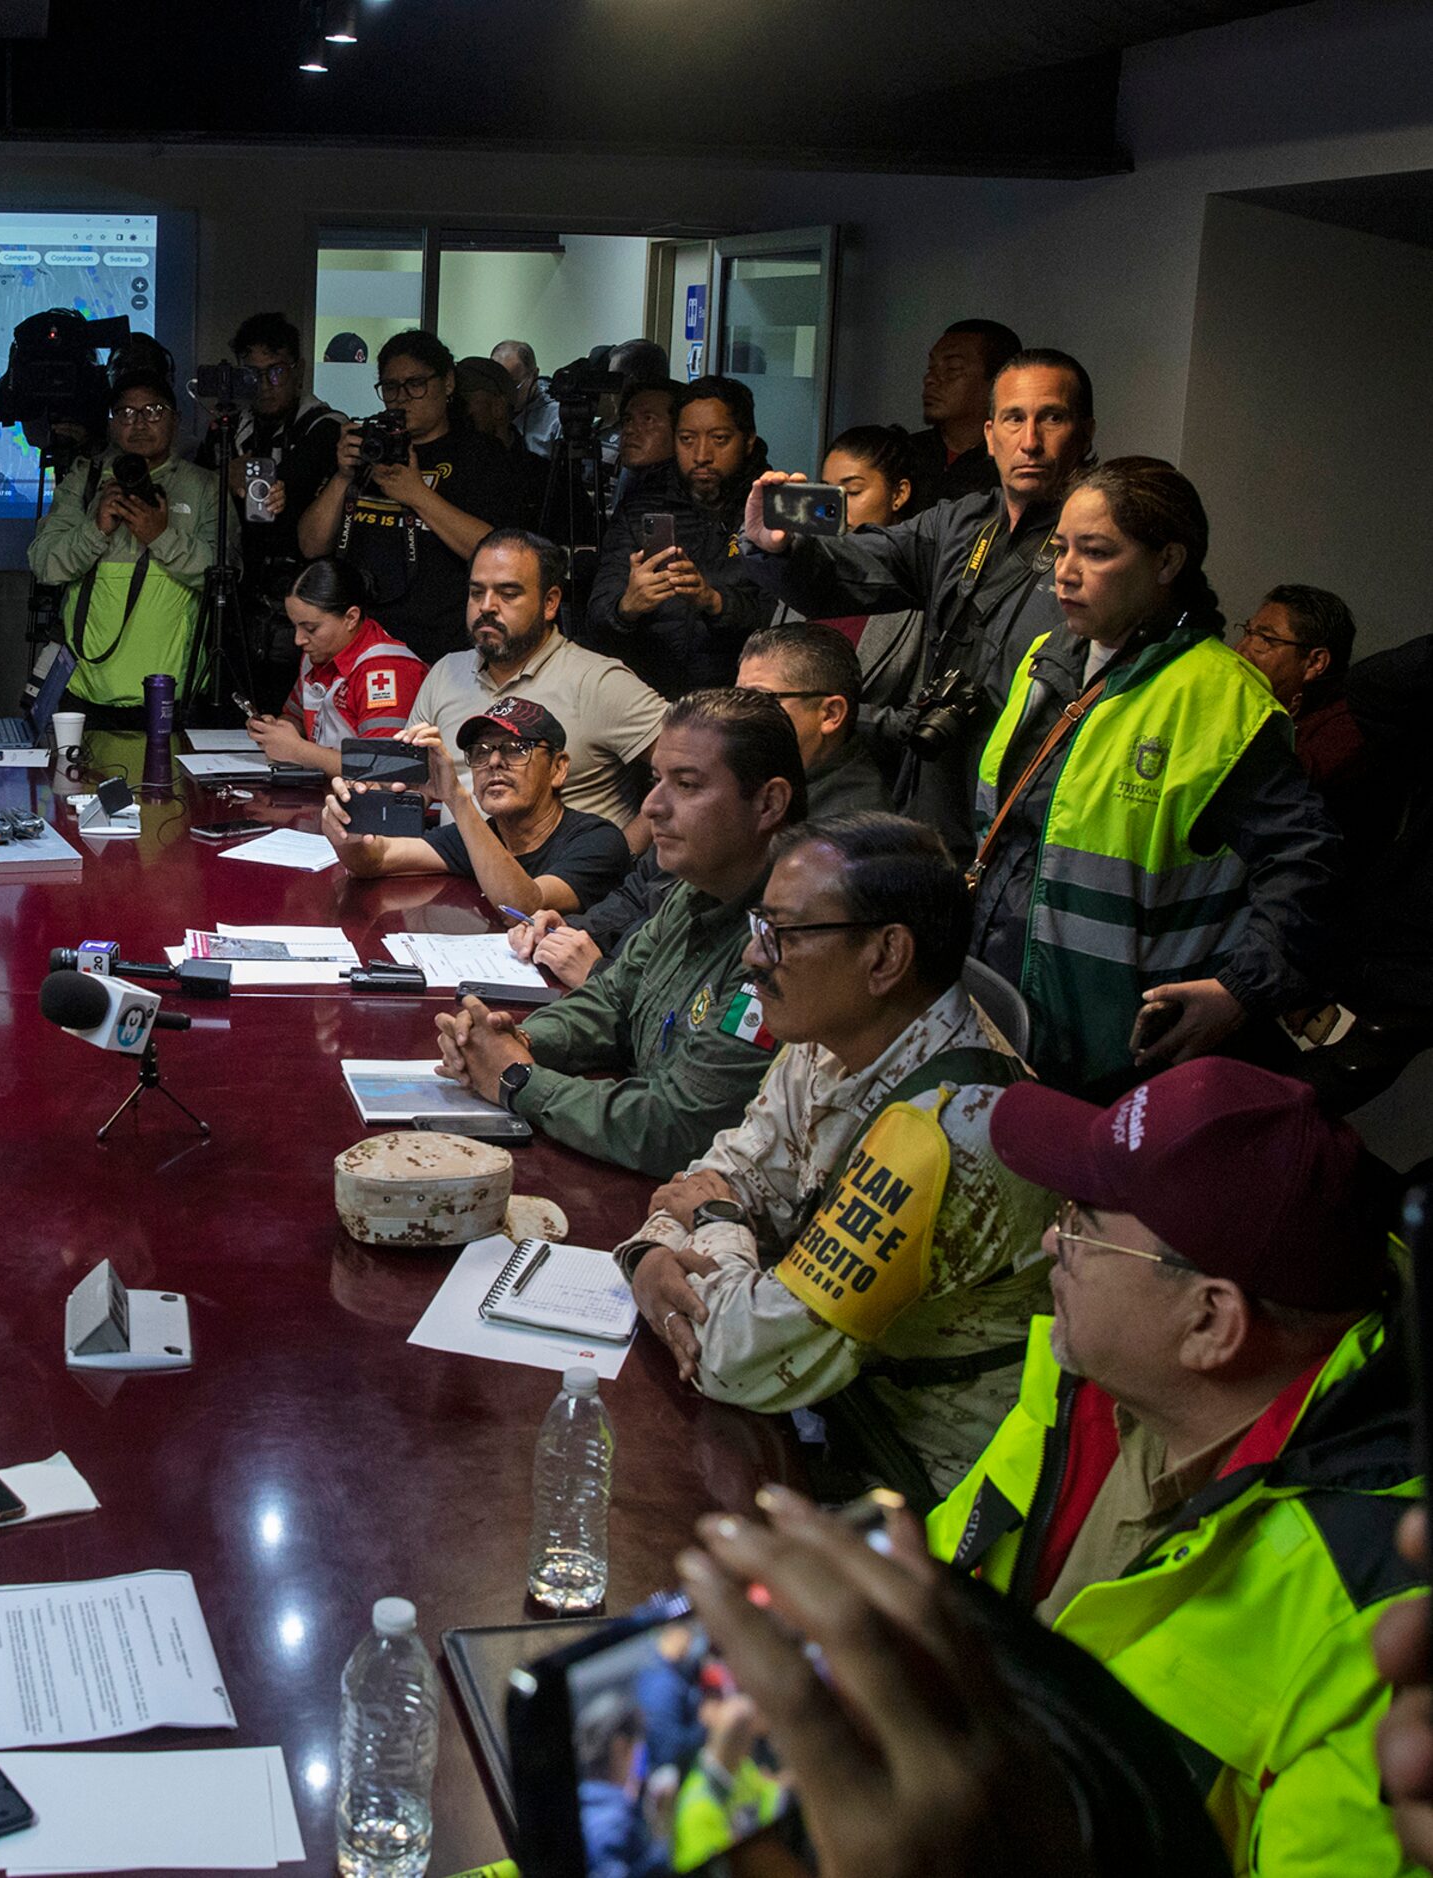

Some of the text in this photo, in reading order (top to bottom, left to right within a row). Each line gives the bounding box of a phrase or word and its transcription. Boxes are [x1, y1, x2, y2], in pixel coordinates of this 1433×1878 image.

[3, 253, 35, 262] Compartir
[51, 254, 94, 263] Configuración
[338, 514, 353, 549] LUMIX
[380, 515, 395, 527] IS
[407, 527, 416, 562] LUMIX
[969, 538, 988, 570] Nikon
[93, 956, 103, 971] 20
[1111, 1100, 1132, 1145] Mayor
[843, 1148, 914, 1217] PLAN
